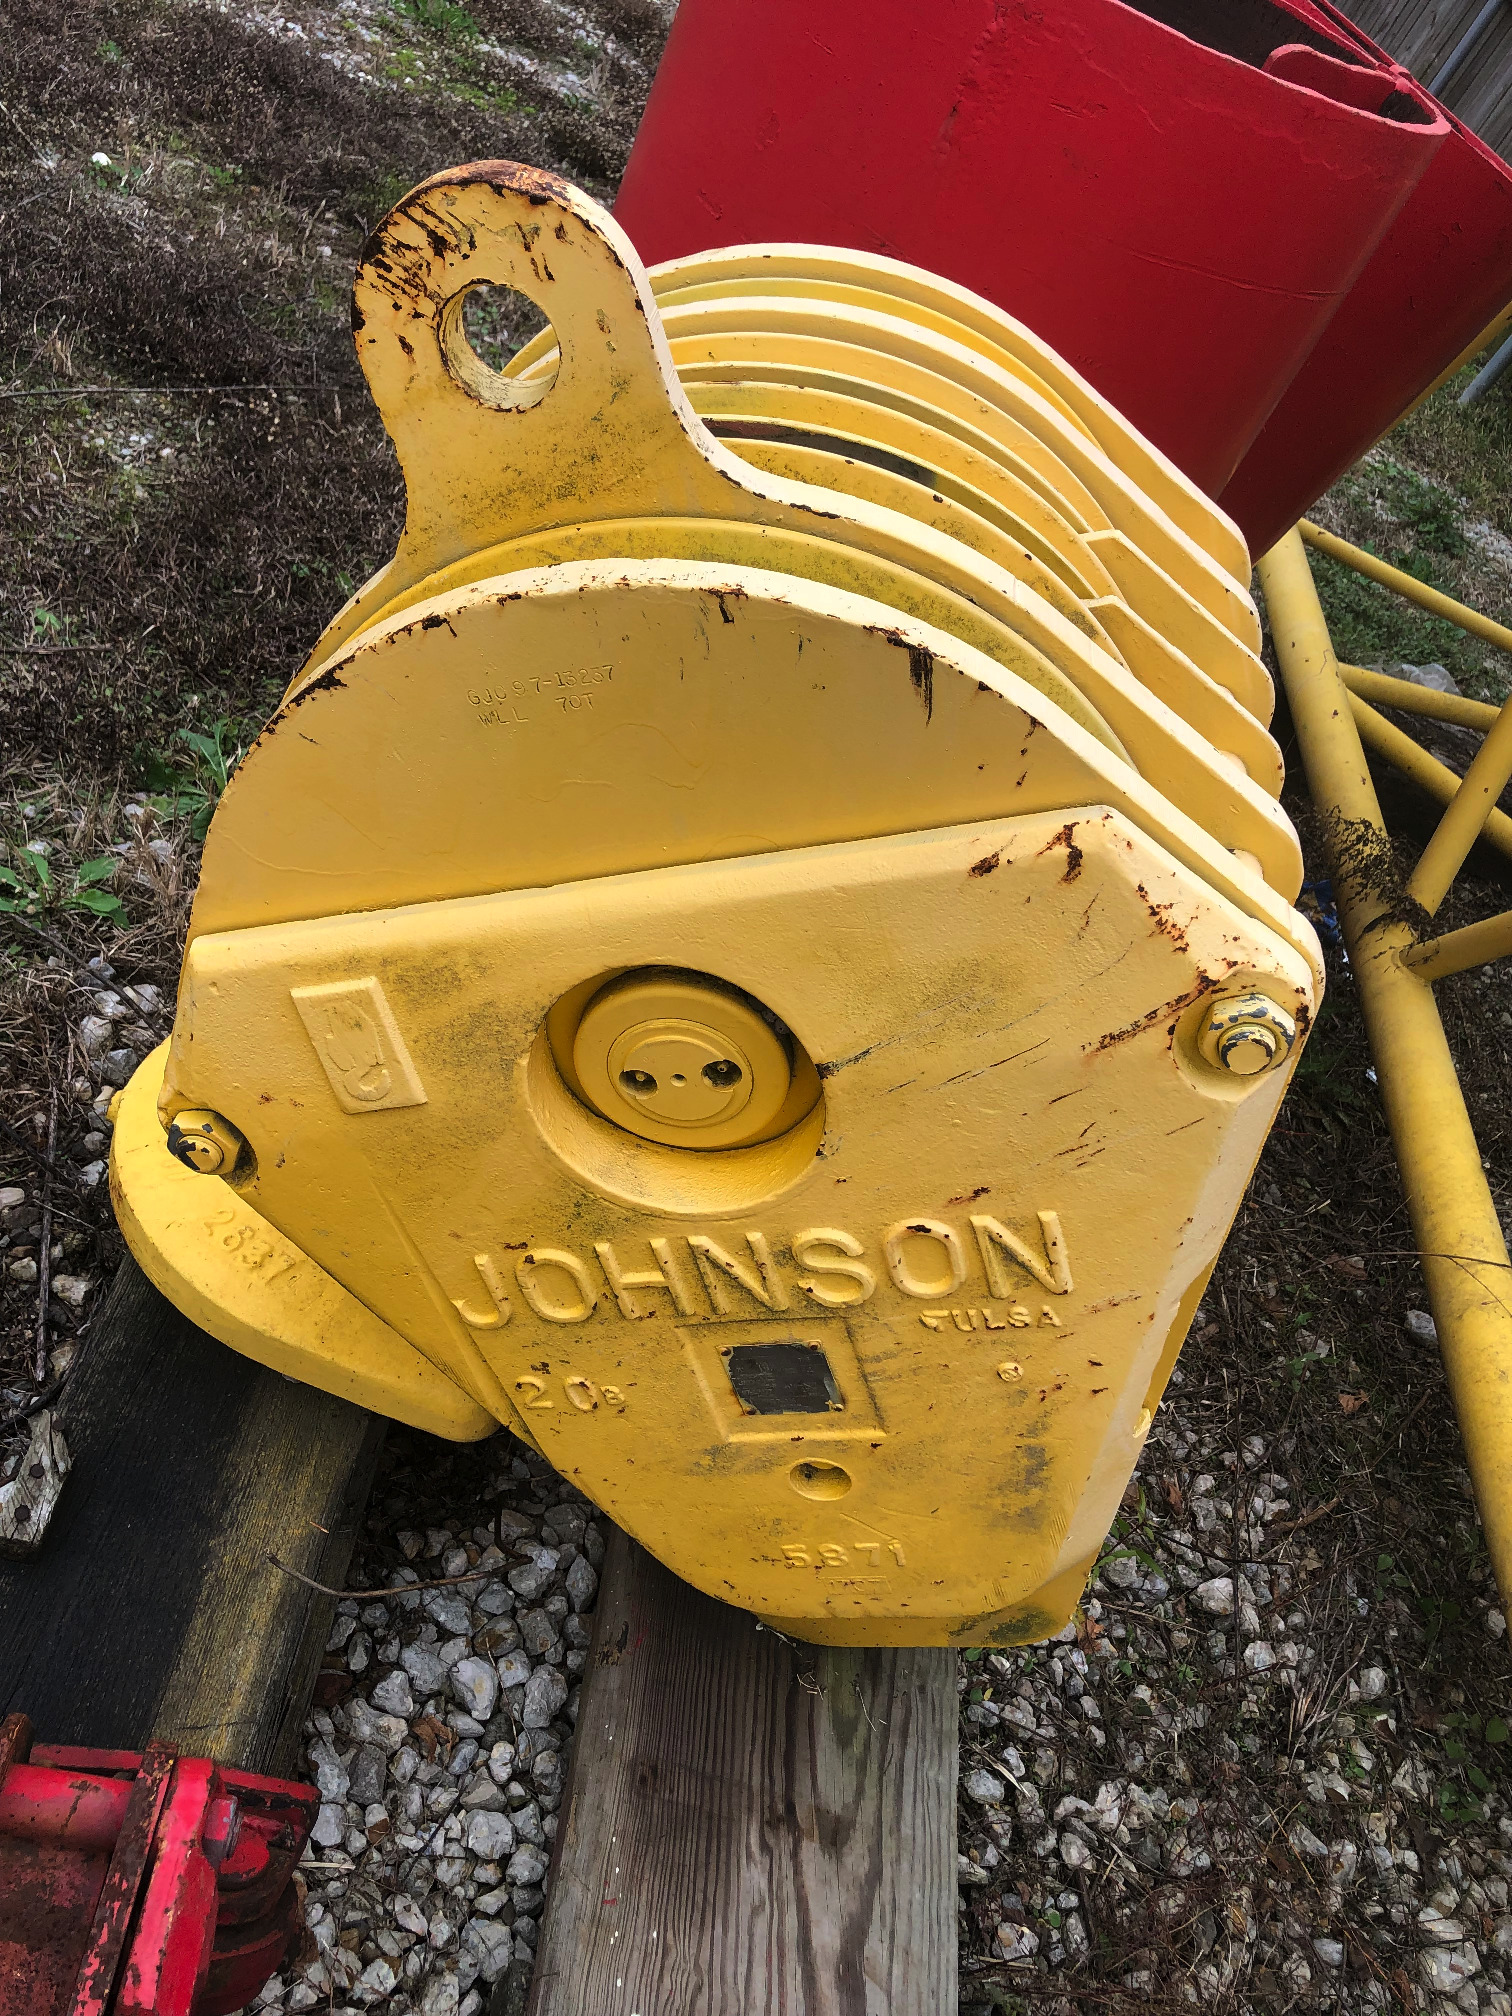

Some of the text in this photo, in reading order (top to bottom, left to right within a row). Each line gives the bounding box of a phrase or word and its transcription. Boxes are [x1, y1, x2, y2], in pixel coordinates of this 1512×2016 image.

[554, 691, 594, 714] 70T
[451, 1209, 1076, 1331] JOHNSON
[918, 1304, 1064, 1334] TULSA
[780, 1538, 907, 1569] 5871
